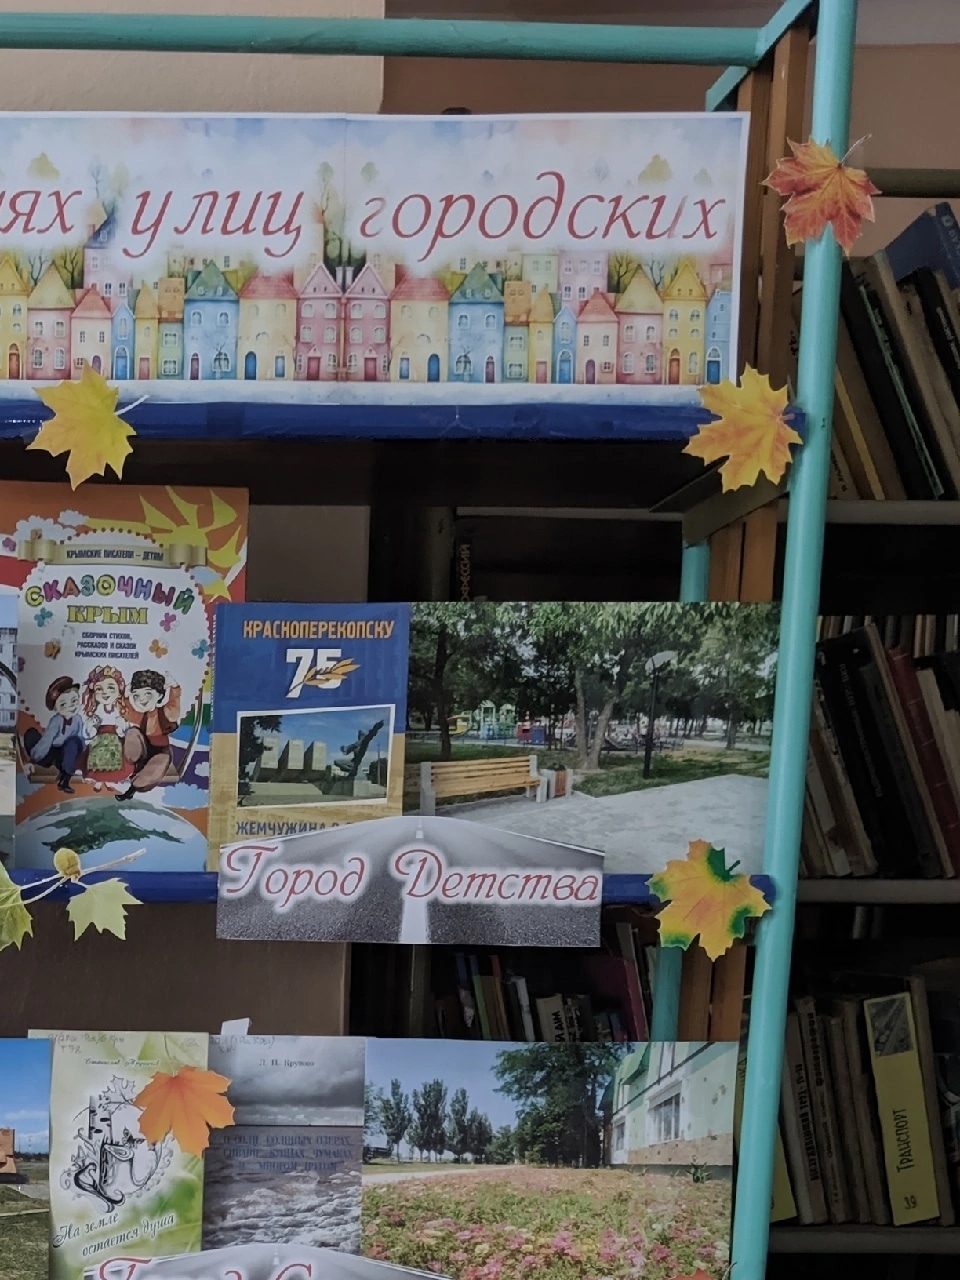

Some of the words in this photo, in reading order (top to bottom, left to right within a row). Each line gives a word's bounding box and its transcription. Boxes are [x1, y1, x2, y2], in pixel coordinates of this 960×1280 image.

[121, 187, 305, 259] улиц
[359, 171, 726, 262] городских
[67, 550, 102, 559] КРЫМСКИЕ
[103, 550, 134, 559] ПИСАТЕЛИ
[24, 574, 196, 615] СКАЗОЧНЫЙ
[67, 605, 148, 624] КРЫМ
[243, 619, 395, 639] КРАСНОПЕРЕКОПСКУ
[285, 648, 343, 698] 75
[225, 845, 365, 908] Город
[394, 849, 599, 901] Детства
[892, 1109, 915, 1173] ТРАНСПОРТ
[903, 1195, 918, 1210] 39
[53, 1223, 81, 1248] На
[84, 1212, 119, 1234] земле
[82, 1230, 138, 1257] остается
[142, 1213, 175, 1241] душа
